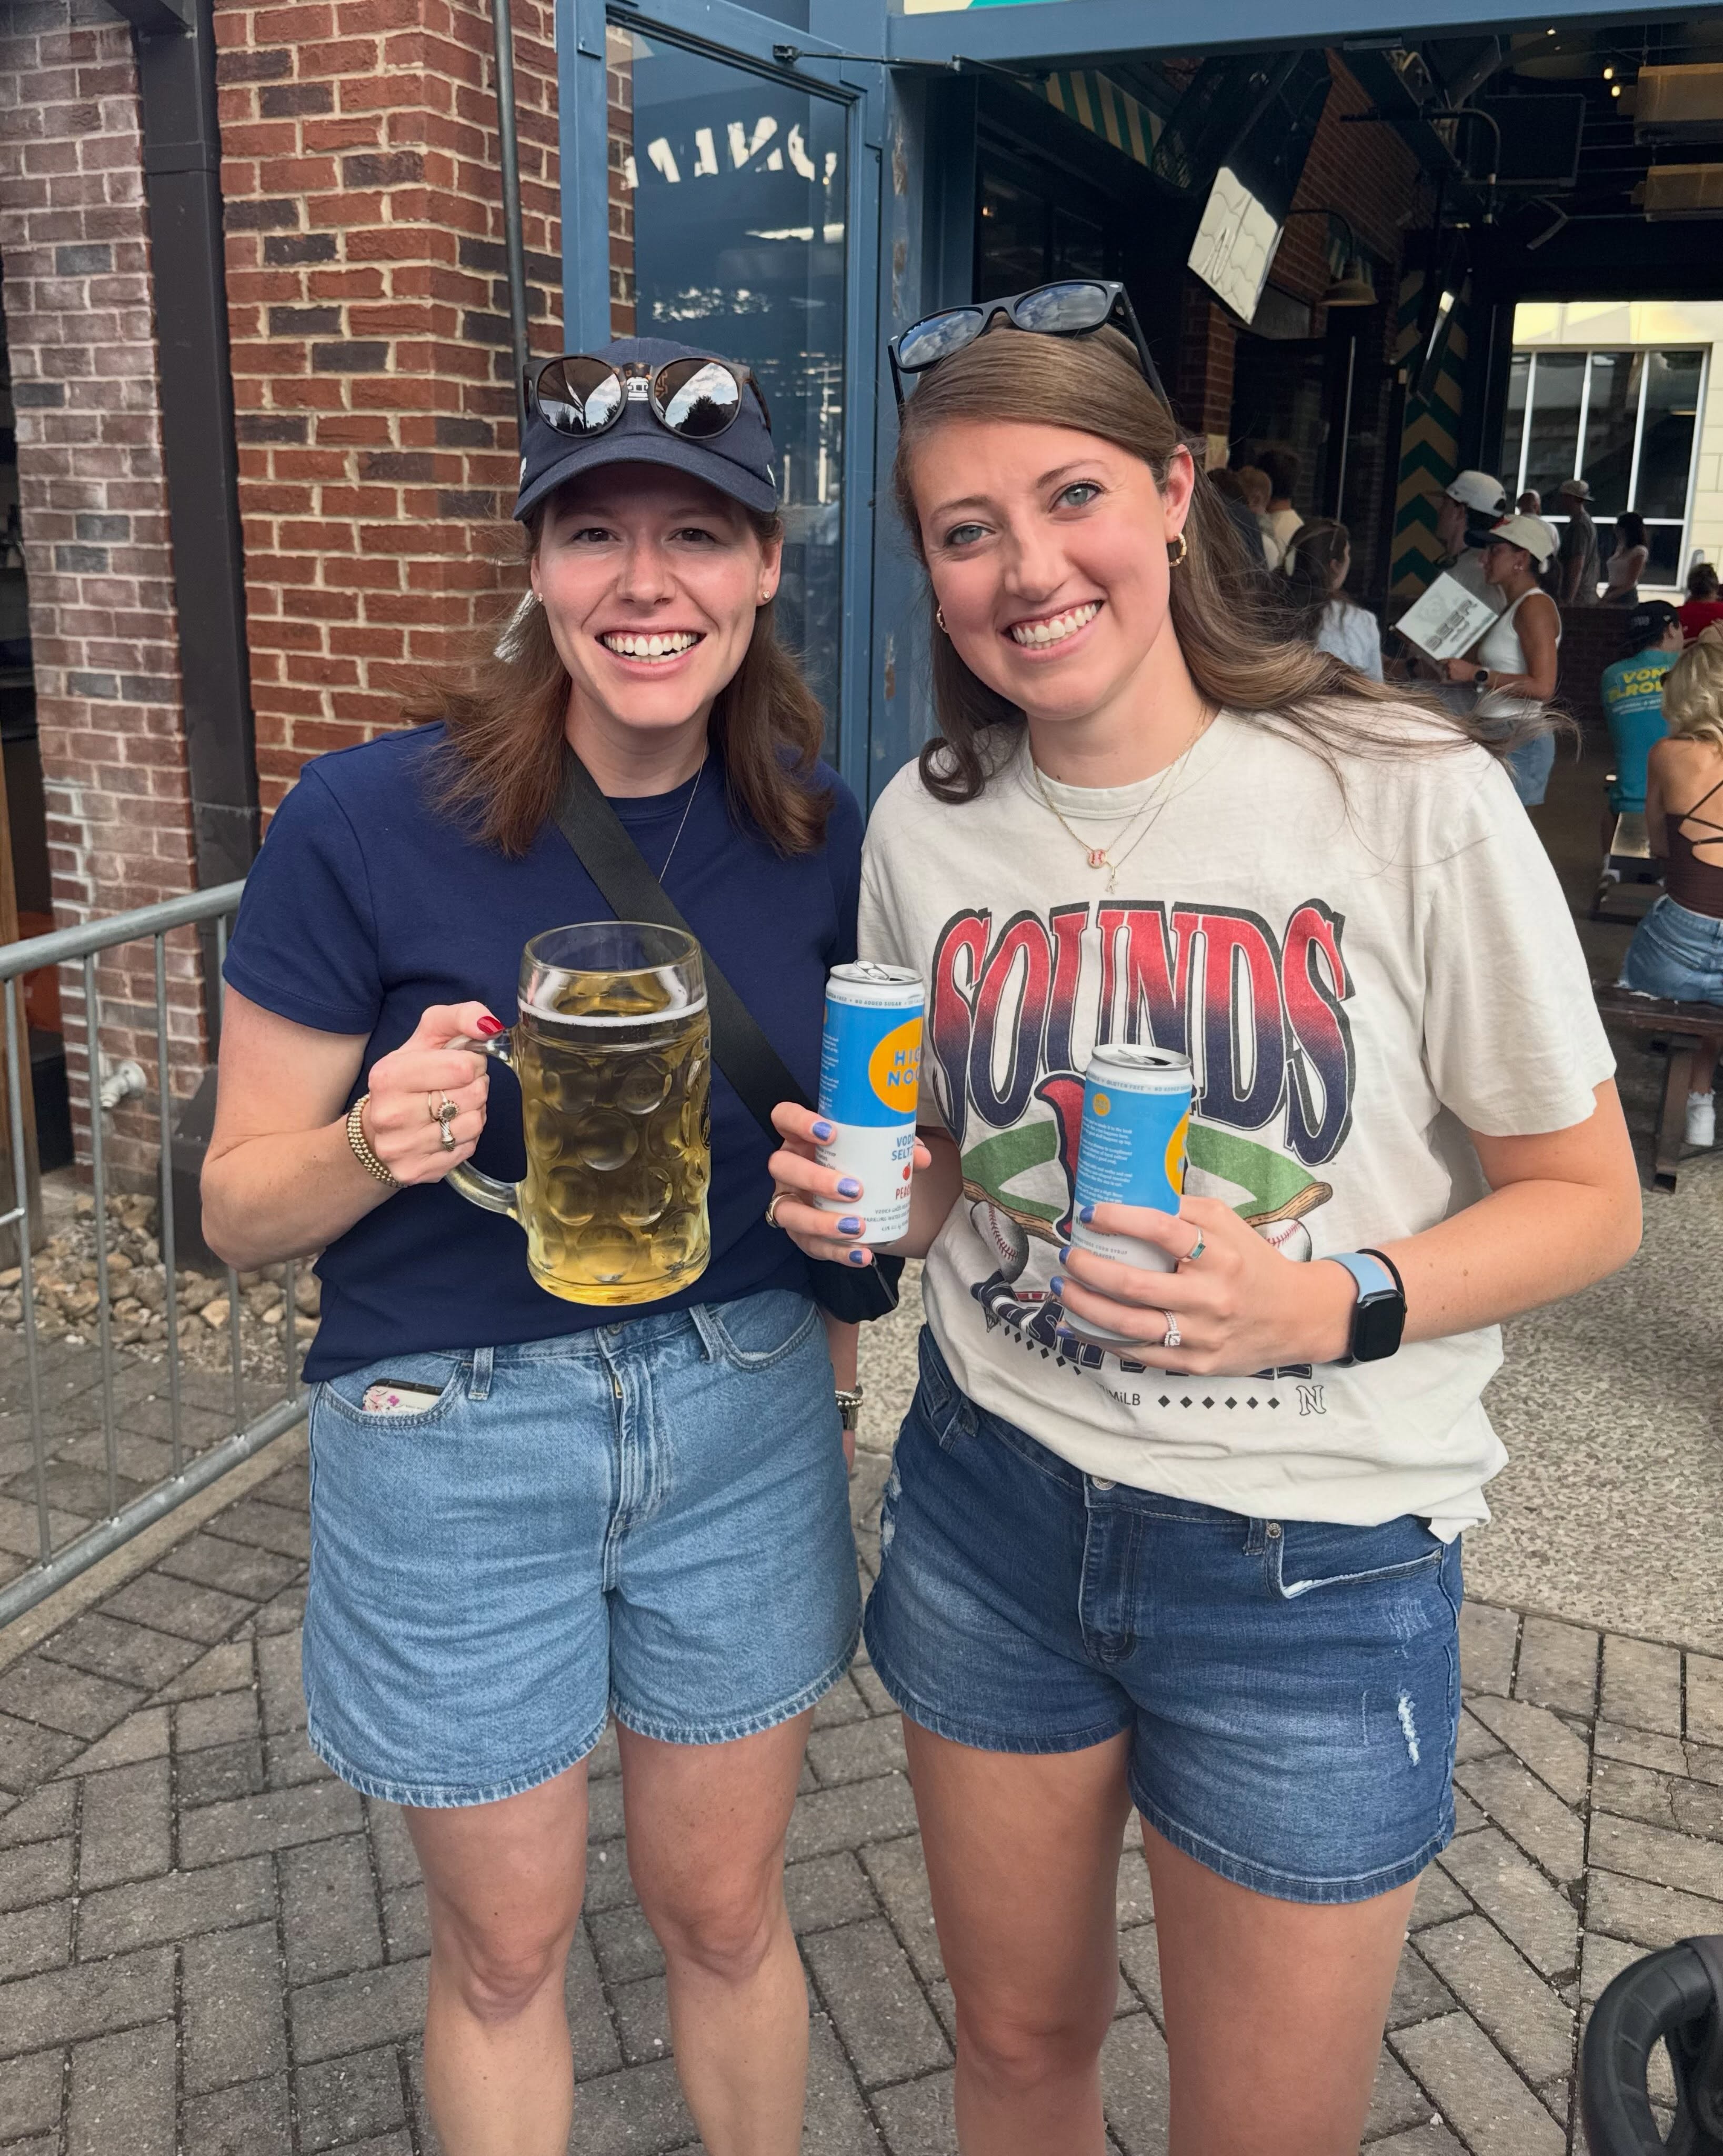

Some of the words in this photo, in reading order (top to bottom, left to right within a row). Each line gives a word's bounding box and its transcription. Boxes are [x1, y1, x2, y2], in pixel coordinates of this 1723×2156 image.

[930, 899, 1355, 1166] SOUNDS
[1106, 1079, 1127, 1089] GLUTEN
[1296, 1384, 1327, 1415] N
